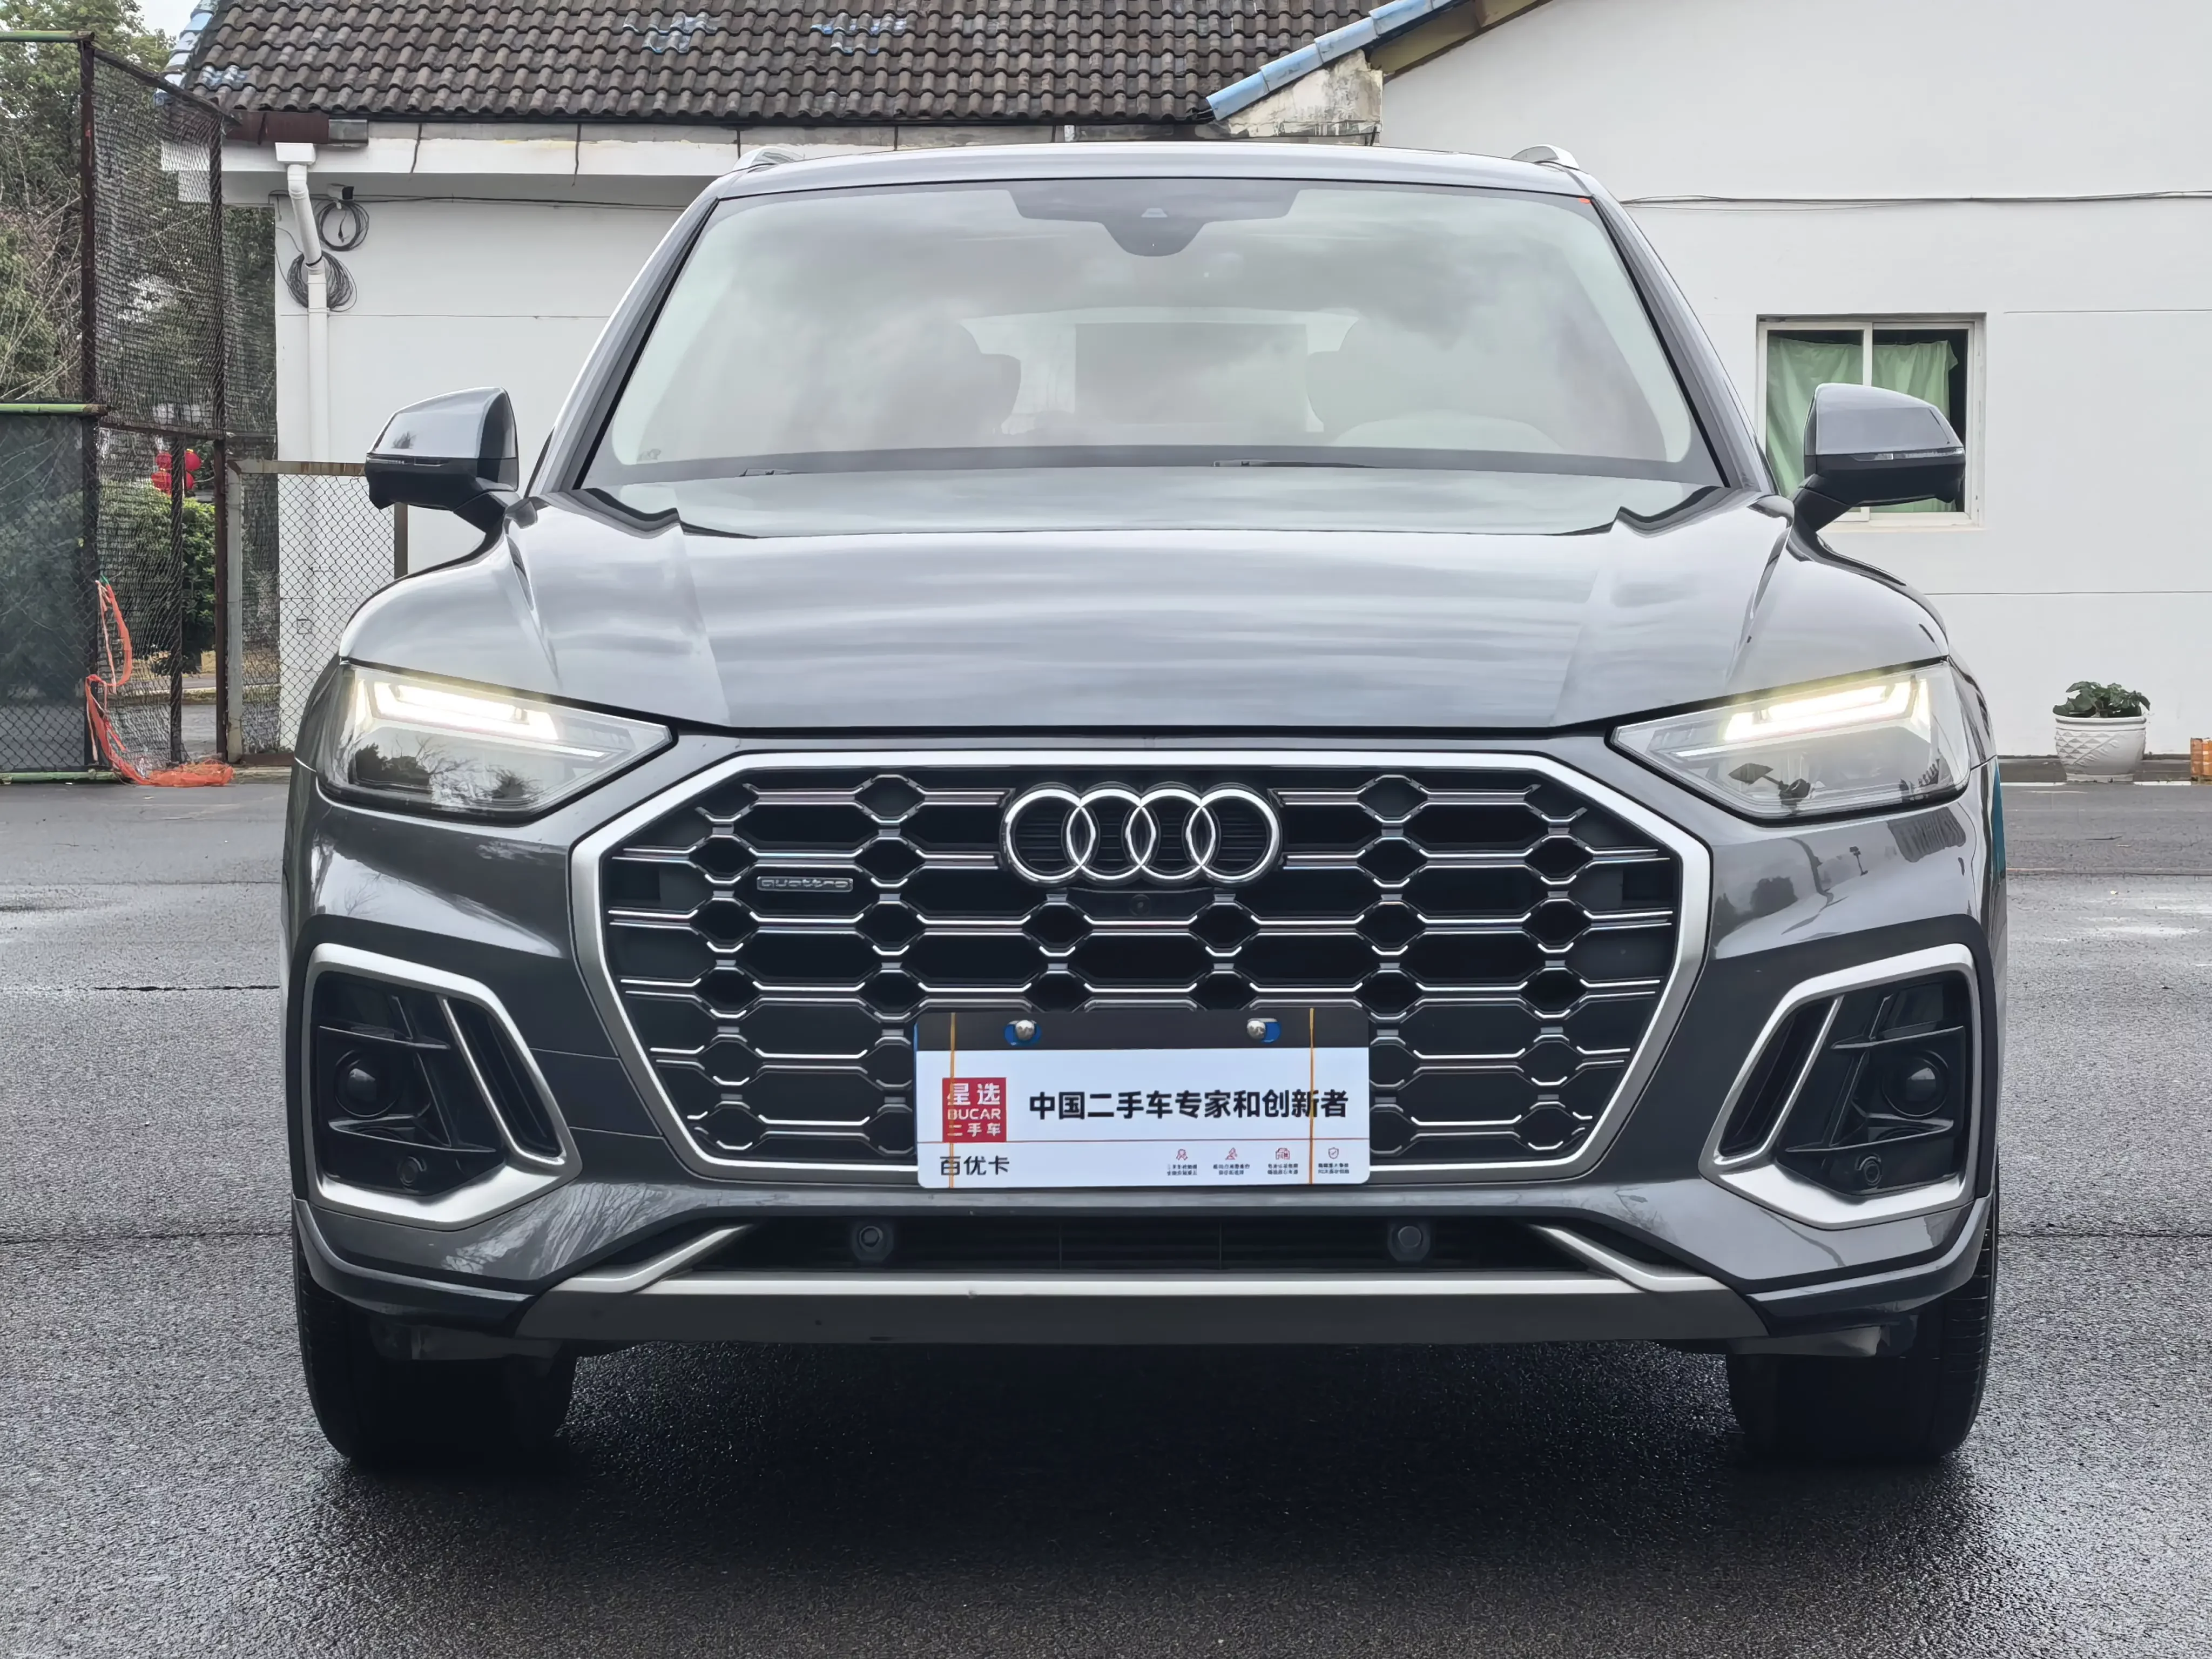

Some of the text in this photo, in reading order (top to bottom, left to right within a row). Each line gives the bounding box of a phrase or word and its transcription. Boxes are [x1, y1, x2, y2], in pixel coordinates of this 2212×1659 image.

[761, 878, 849, 888] quattro
[947, 1082, 1000, 1105] 星选
[1029, 1089, 1349, 1120] 中国二手车专家和创新者
[948, 1108, 1001, 1120] BUCAR
[947, 1122, 1001, 1137] 二手车
[940, 1155, 1010, 1176] 百优卡
